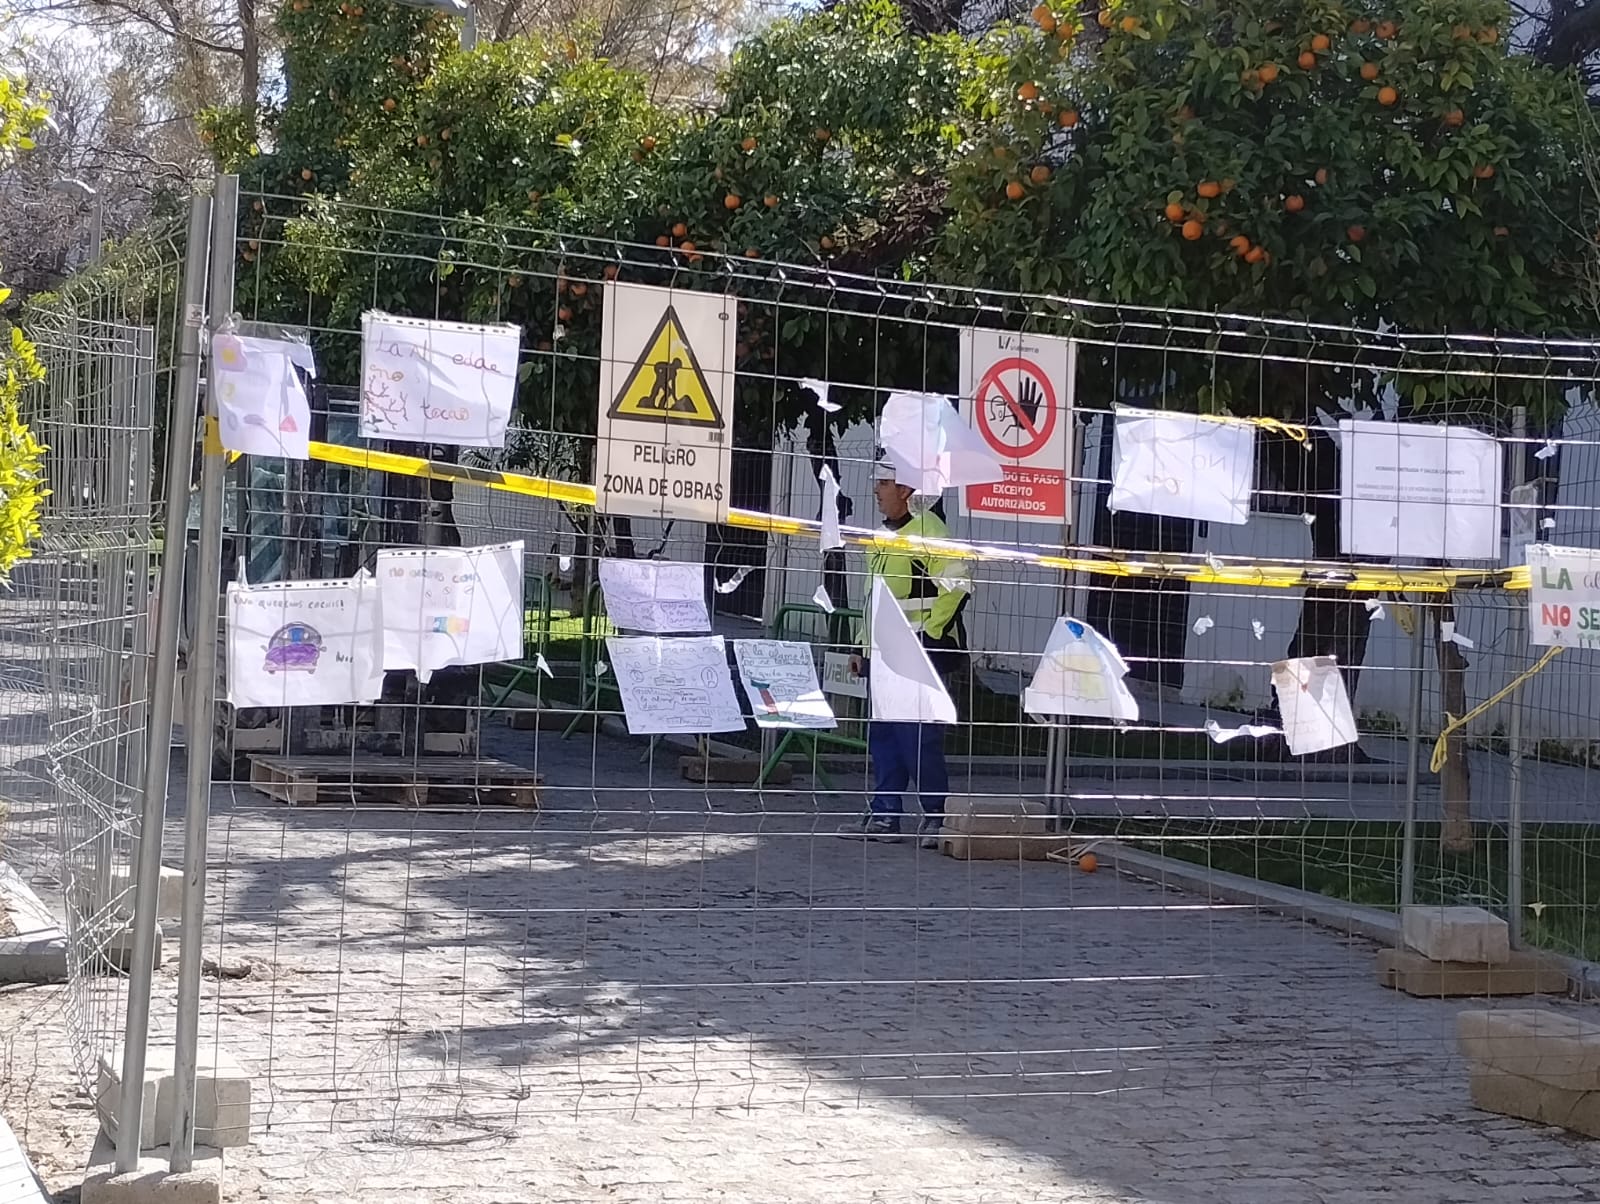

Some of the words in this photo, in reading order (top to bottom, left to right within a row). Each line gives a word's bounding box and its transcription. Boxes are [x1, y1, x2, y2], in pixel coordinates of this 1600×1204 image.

[633, 445, 696, 466] PELIGRO
[603, 474, 644, 495] ZONA
[649, 478, 668, 497] DE
[673, 480, 723, 501] OBRAS
[1020, 473, 1032, 483] EL
[1033, 474, 1060, 485] PASO
[992, 483, 1033, 497] EXCEPTO
[980, 496, 1046, 511] AUTORIZADOS
[1541, 566, 1573, 590] LA
[1541, 603, 1571, 627] NO
[1577, 607, 1600, 630] SE
